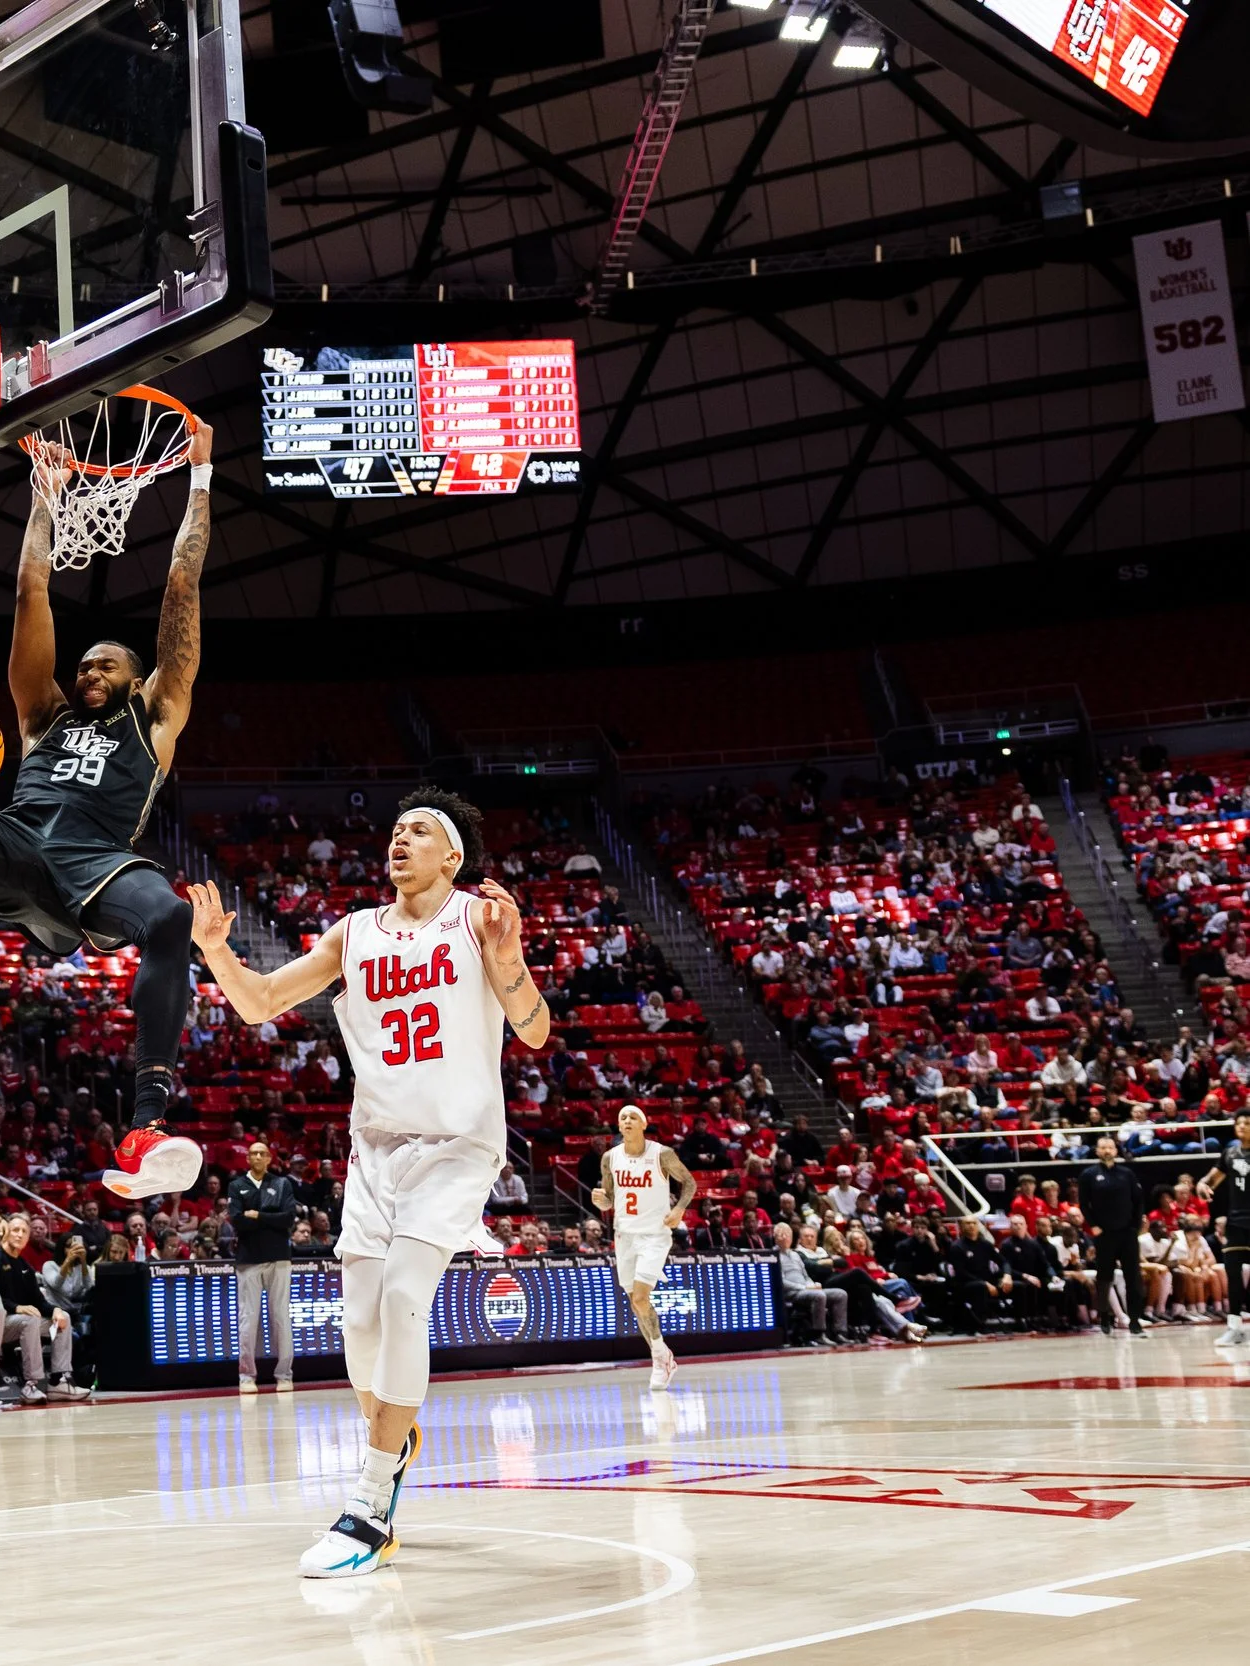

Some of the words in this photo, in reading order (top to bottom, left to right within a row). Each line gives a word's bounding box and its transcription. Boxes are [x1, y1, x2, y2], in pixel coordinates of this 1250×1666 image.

[1119, 34, 1161, 96] 42
[1158, 267, 1207, 287] WOMEN'S
[1150, 279, 1217, 302] BASKETBALL
[1154, 315, 1226, 354] 582
[1177, 374, 1213, 393] ELAINE
[1176, 388, 1218, 407] ELLIOTT
[343, 458, 373, 479] 47
[472, 454, 503, 476] 42
[553, 472, 576, 482] Bank
[1117, 561, 1150, 582] ss
[61, 726, 120, 757] UCF
[50, 756, 106, 787] 99
[359, 943, 458, 1002] Utah
[381, 1002, 444, 1067] 32
[615, 1170, 653, 1188] Utah
[1235, 1176, 1246, 1192] 4
[626, 1192, 638, 1215] 2
[155, 1266, 190, 1275] Trucordia
[200, 1264, 235, 1274] Trucordia
[291, 1262, 318, 1271] rucordia
